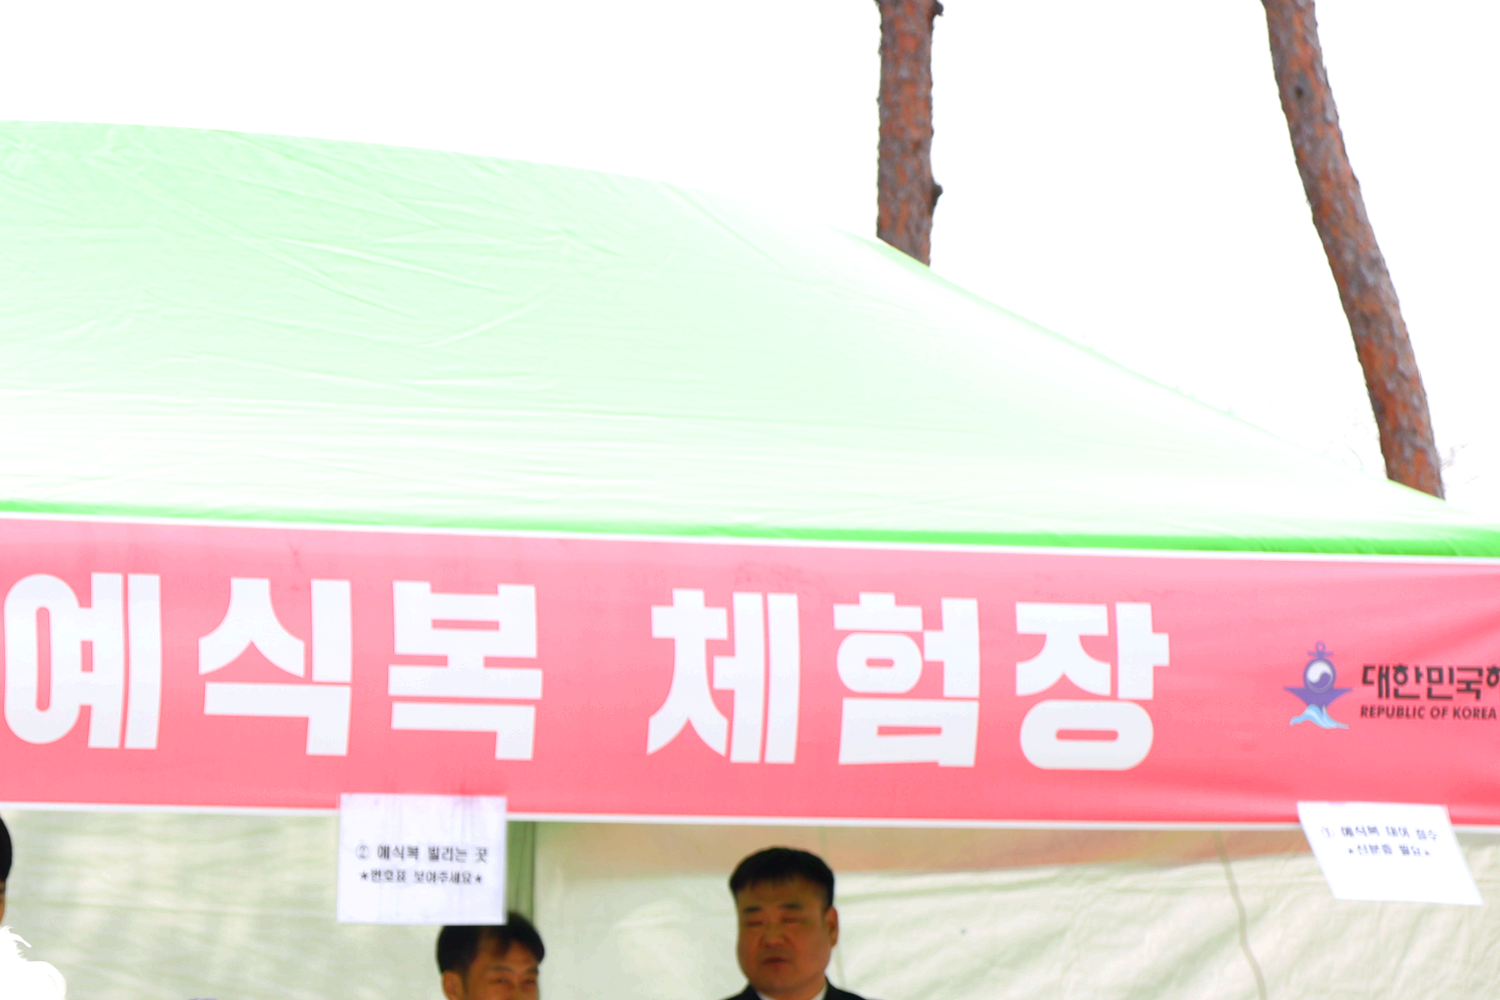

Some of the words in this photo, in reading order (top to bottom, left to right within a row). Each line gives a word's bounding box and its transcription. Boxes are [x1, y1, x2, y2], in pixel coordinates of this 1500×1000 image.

[4, 571, 543, 760] 예식복
[646, 588, 1170, 771] 체험장
[1360, 705, 1425, 719] REPUBLIC
[1430, 706, 1448, 720] OF
[1453, 707, 1497, 720] KOREA
